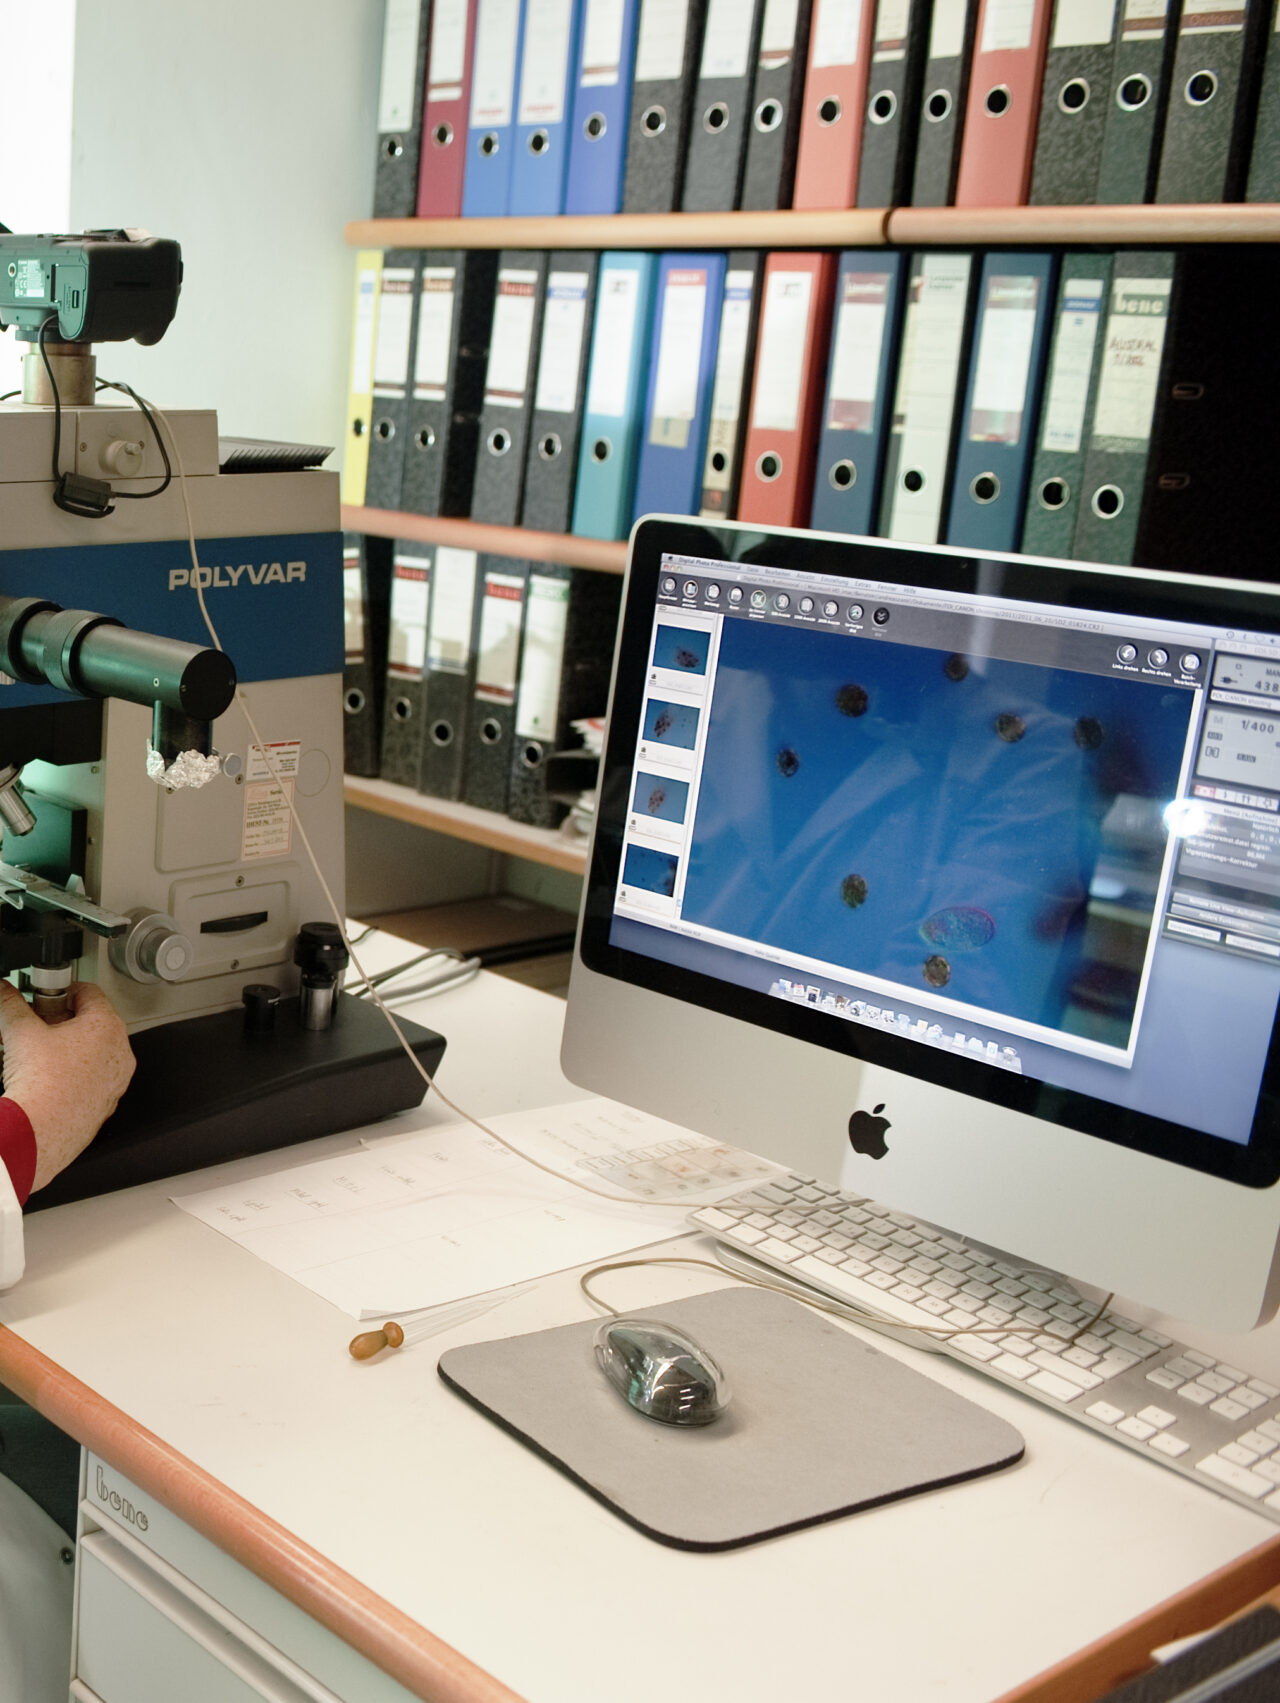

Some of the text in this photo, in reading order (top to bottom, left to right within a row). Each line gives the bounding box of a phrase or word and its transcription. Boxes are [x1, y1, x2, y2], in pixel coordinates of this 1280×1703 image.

[1115, 291, 1164, 314] bene
[678, 557, 695, 565] Digital
[711, 561, 741, 571] Professional
[168, 561, 307, 591] POLYVAR
[1241, 719, 1274, 734] 1/400
[96, 1464, 149, 1532] bene
